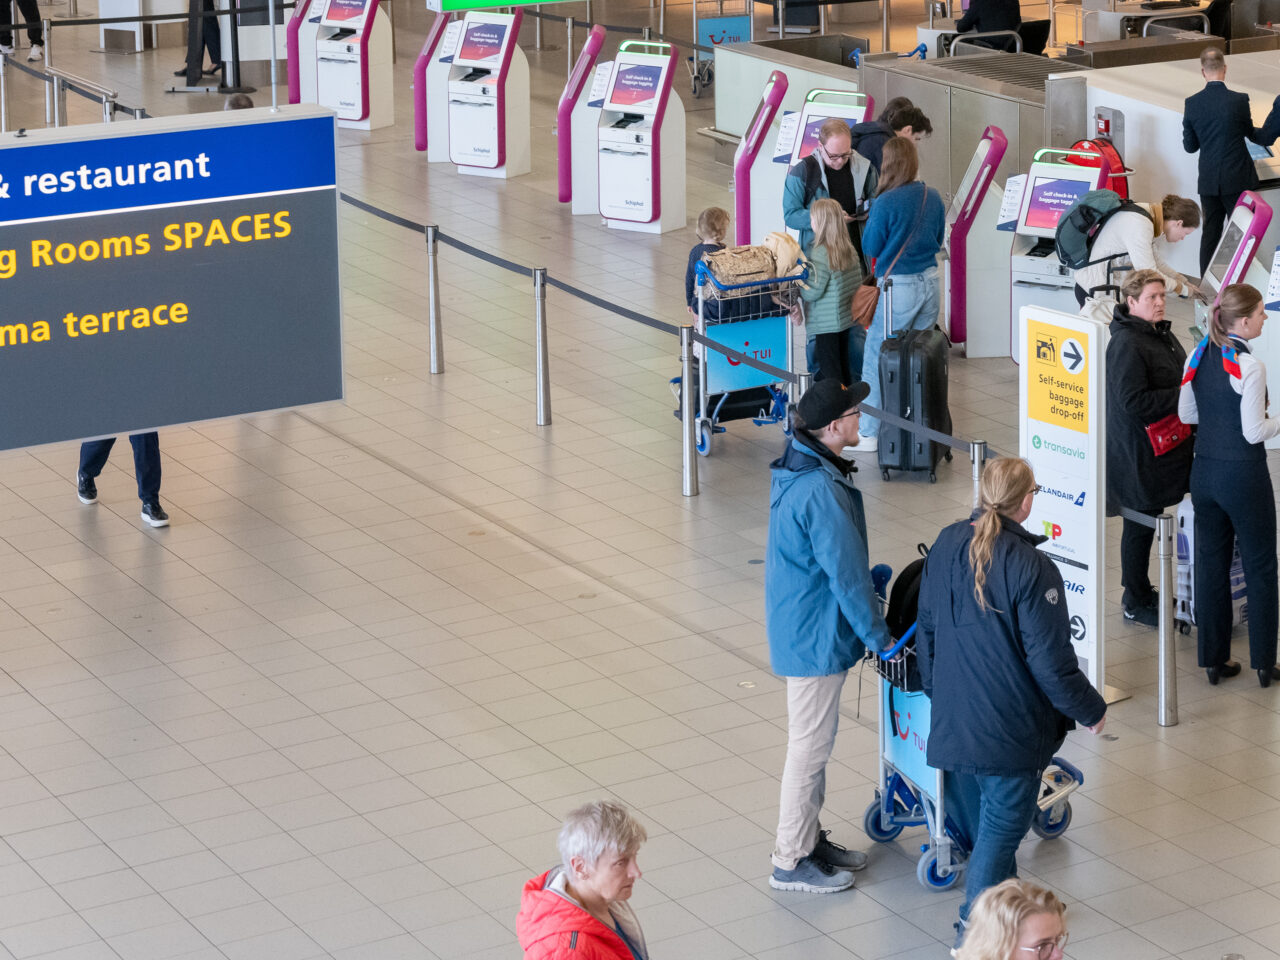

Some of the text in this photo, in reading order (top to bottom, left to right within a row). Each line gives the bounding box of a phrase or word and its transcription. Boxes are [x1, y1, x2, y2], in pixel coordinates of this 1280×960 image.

[728, 35, 741, 43] TUI
[24, 152, 211, 196] restaurant
[1038, 196, 1060, 204] baggage
[31, 233, 151, 268] Rooms
[163, 210, 292, 252] SPACES
[63, 301, 189, 338] terrace
[752, 348, 772, 360] TUI
[1038, 373, 1084, 394] Self-service
[1049, 390, 1084, 408] baggage
[1050, 404, 1084, 422] drop-off
[1043, 439, 1086, 460] transavia
[1042, 519, 1063, 540] TAP
[913, 731, 927, 753] TUI
